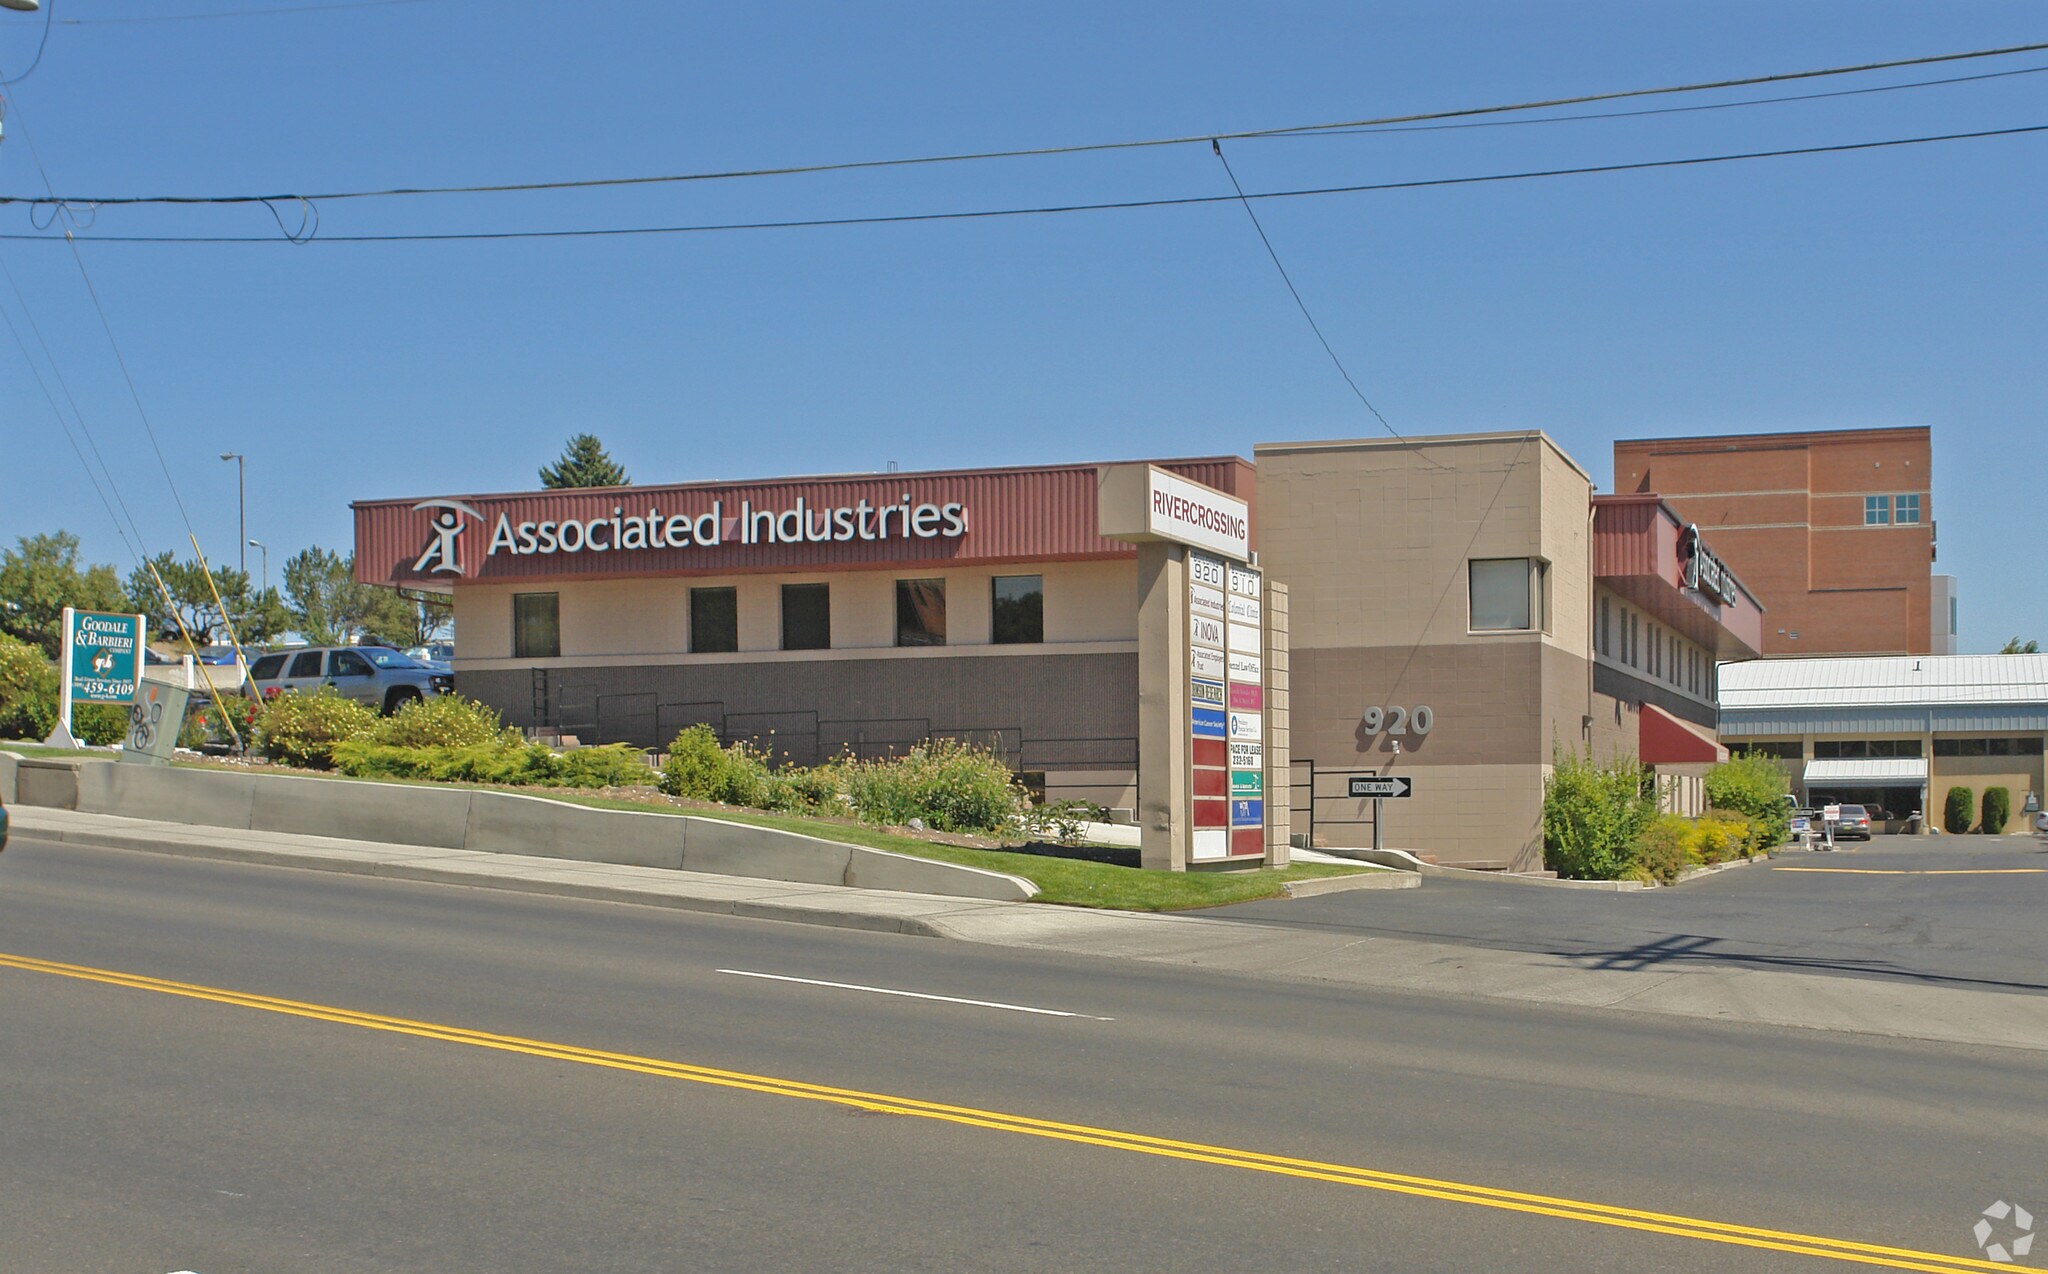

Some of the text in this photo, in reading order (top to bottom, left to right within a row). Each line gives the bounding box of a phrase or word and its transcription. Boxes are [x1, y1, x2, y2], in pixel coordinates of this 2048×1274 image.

[487, 493, 966, 556] Associated Industries
[1153, 489, 1246, 540] RIVERCROSSING
[1194, 563, 1219, 584] 920
[1231, 575, 1254, 596] 910
[75, 629, 88, 649] &
[1200, 621, 1219, 643] INOVA
[84, 682, 135, 696] 459-6109
[1363, 704, 1434, 736] 920
[1241, 744, 1249, 755] FOR
[1249, 745, 1262, 756] LEASE
[1354, 783, 1394, 792] ONE WAY
